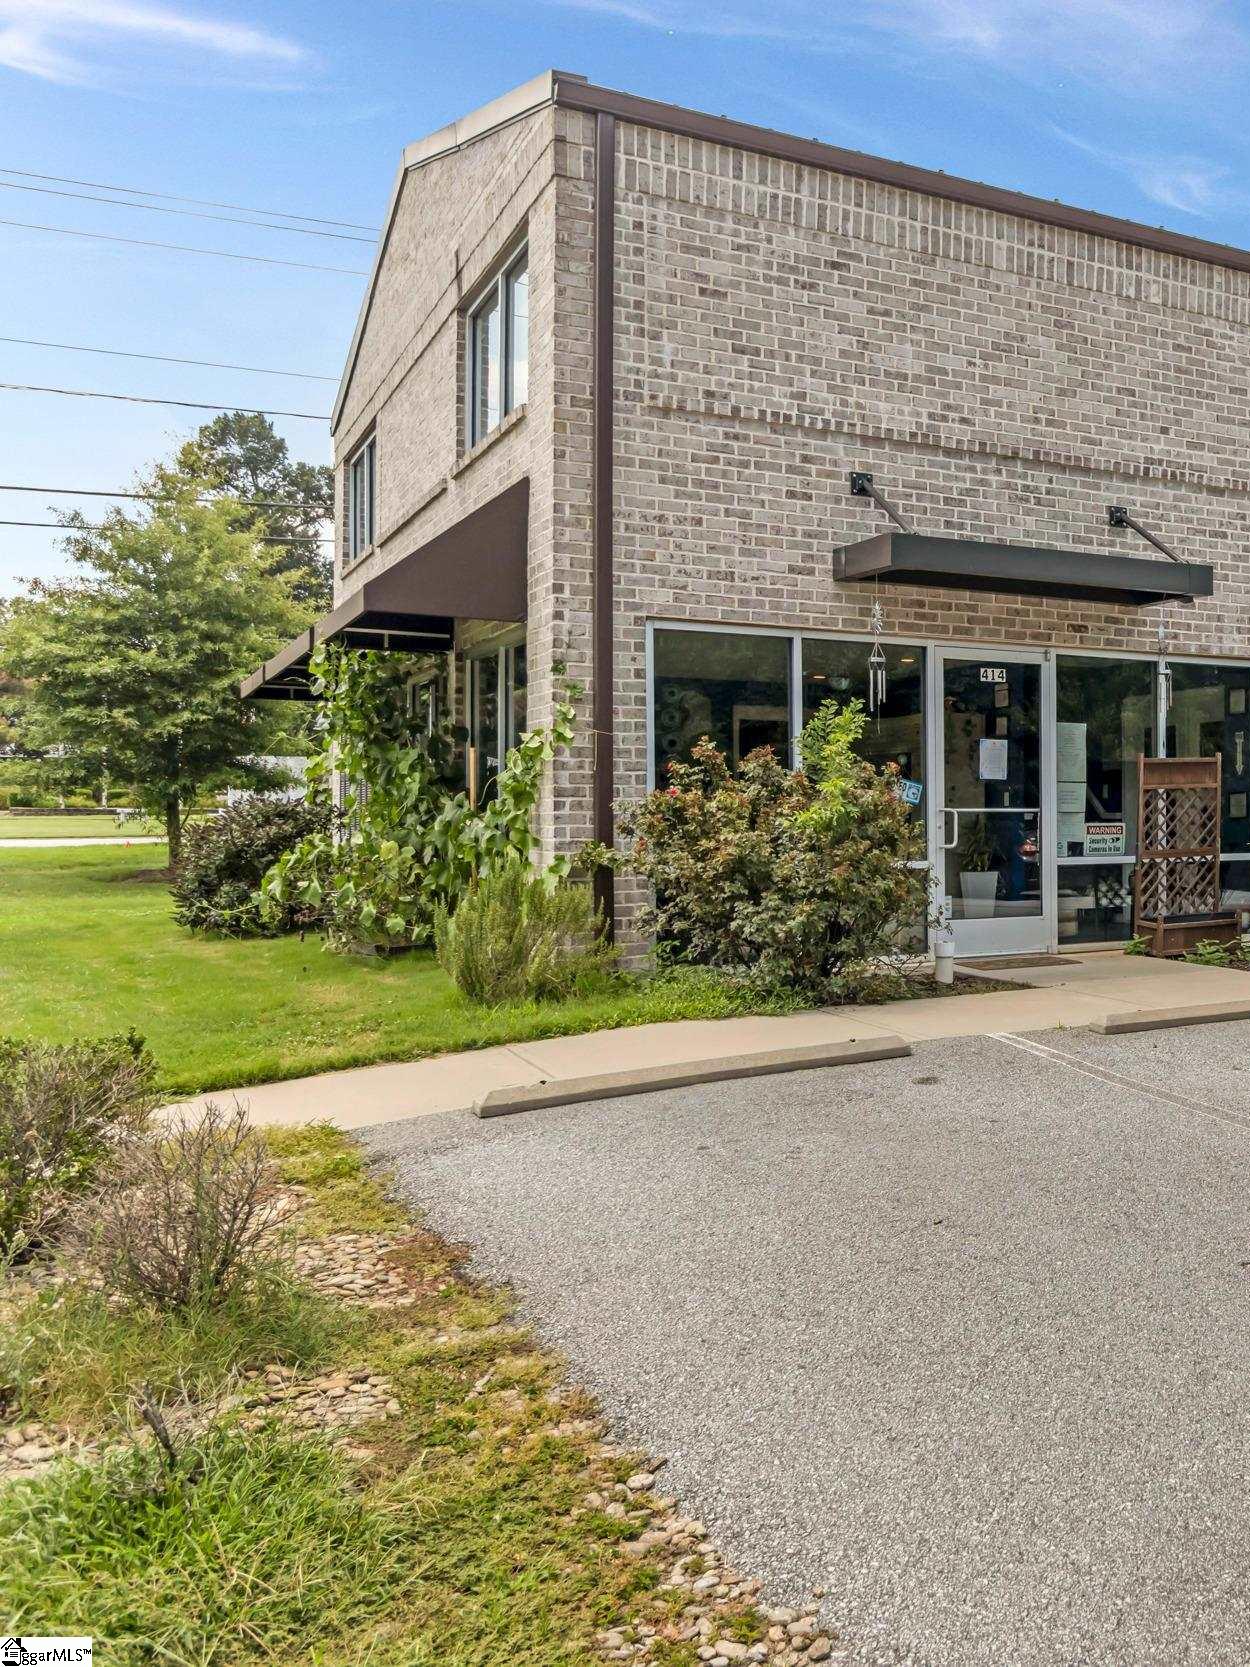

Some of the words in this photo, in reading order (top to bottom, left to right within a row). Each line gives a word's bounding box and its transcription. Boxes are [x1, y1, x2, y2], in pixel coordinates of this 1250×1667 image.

[982, 669, 1005, 681] 414
[1088, 826, 1122, 834] WARNING
[1088, 837, 1108, 845] Security
[1088, 845, 1107, 853] Cameras
